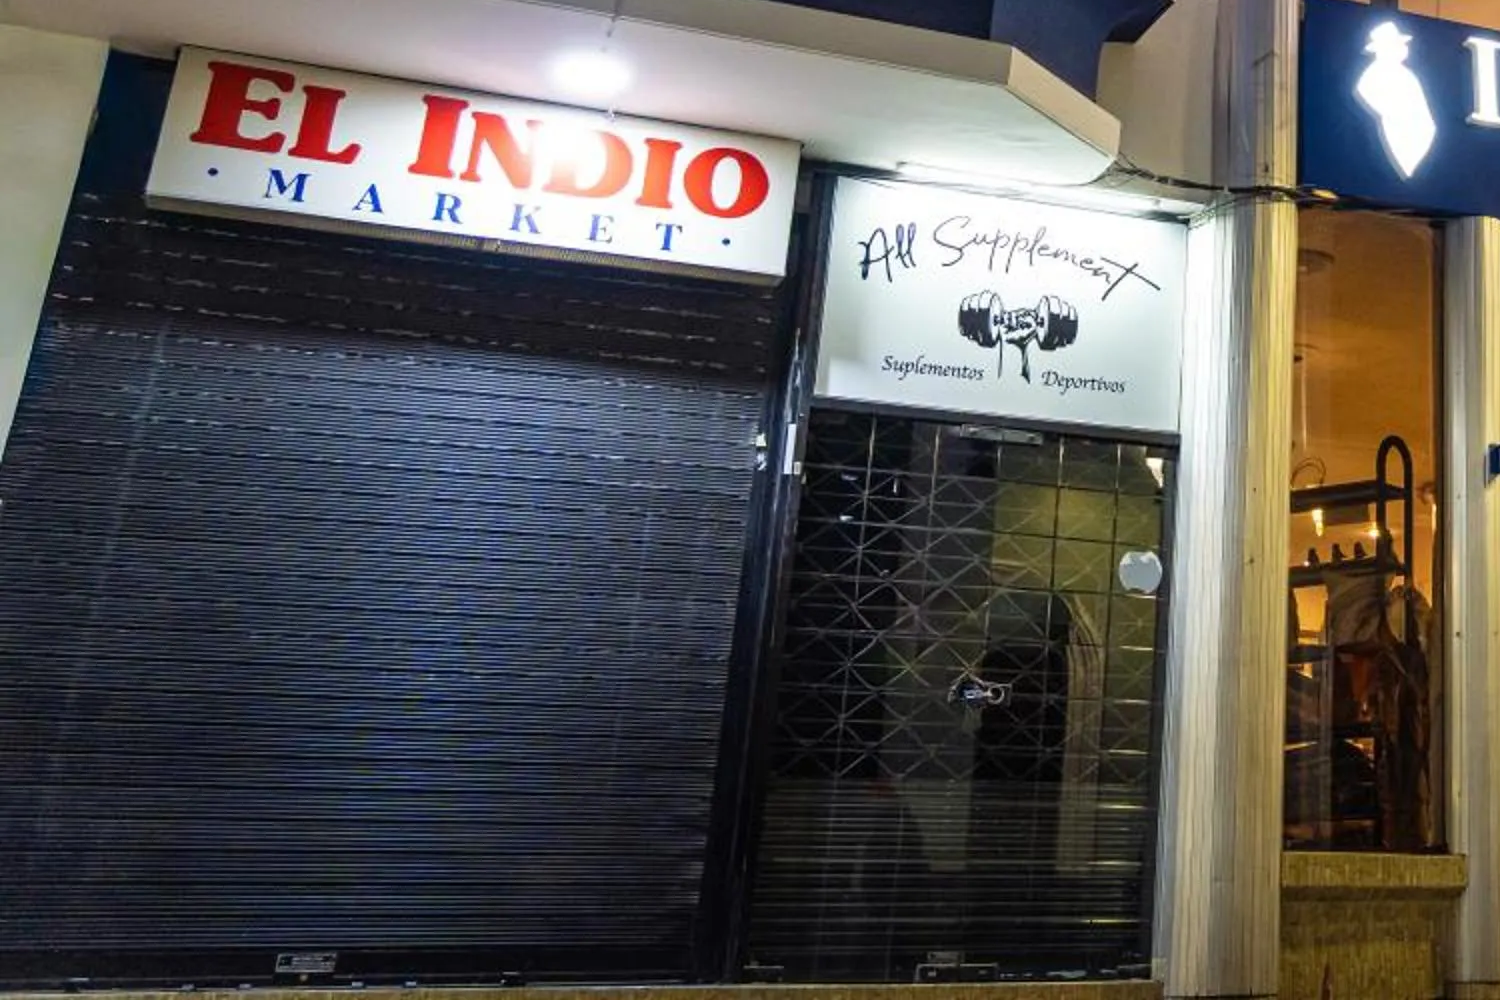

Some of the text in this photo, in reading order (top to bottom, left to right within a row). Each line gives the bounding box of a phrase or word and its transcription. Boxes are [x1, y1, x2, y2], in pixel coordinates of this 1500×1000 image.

[190, 60, 770, 219] EL INDIO
[264, 168, 684, 252] MARKET
[858, 215, 1161, 301] All Supplement
[881, 354, 1126, 394] Suplementos Deportivos
